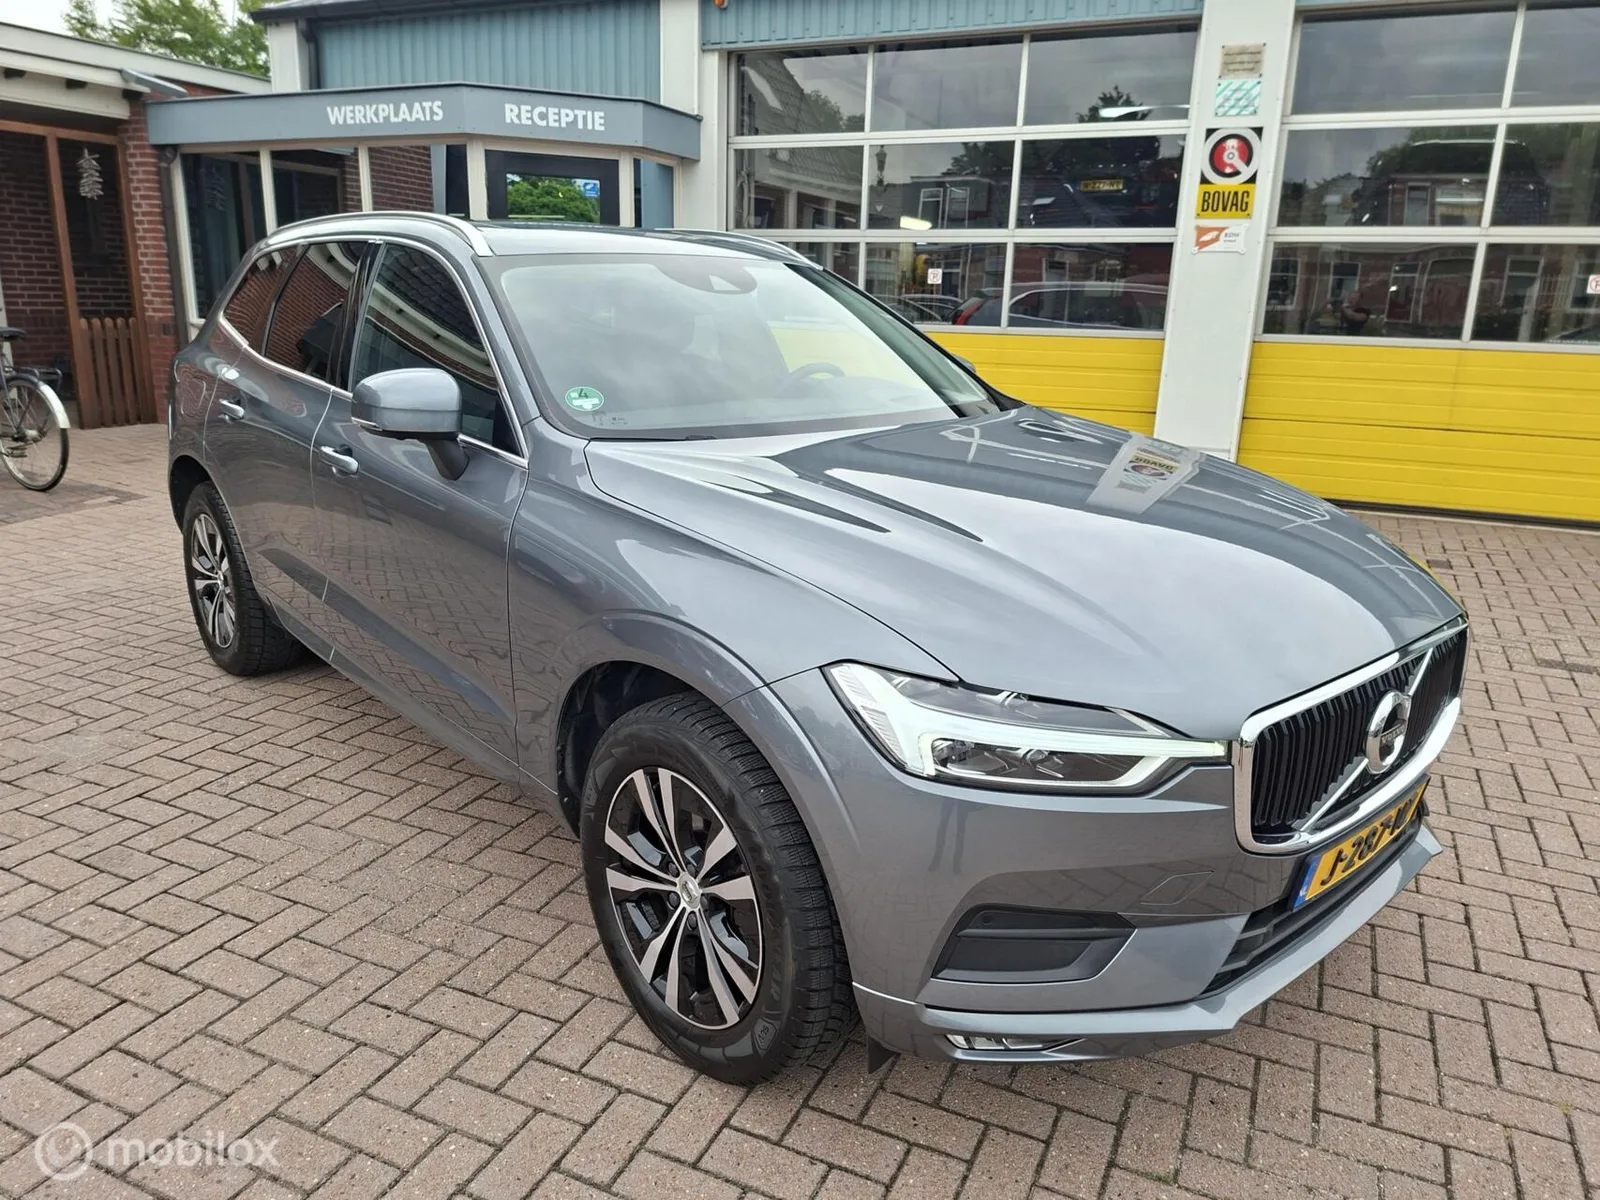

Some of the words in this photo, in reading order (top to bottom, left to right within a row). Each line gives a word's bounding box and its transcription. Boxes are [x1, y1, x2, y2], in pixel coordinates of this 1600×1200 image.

[326, 100, 444, 125] WERKPLAATS
[504, 103, 605, 131] RECEPTIE
[1201, 190, 1250, 213] BOVAG
